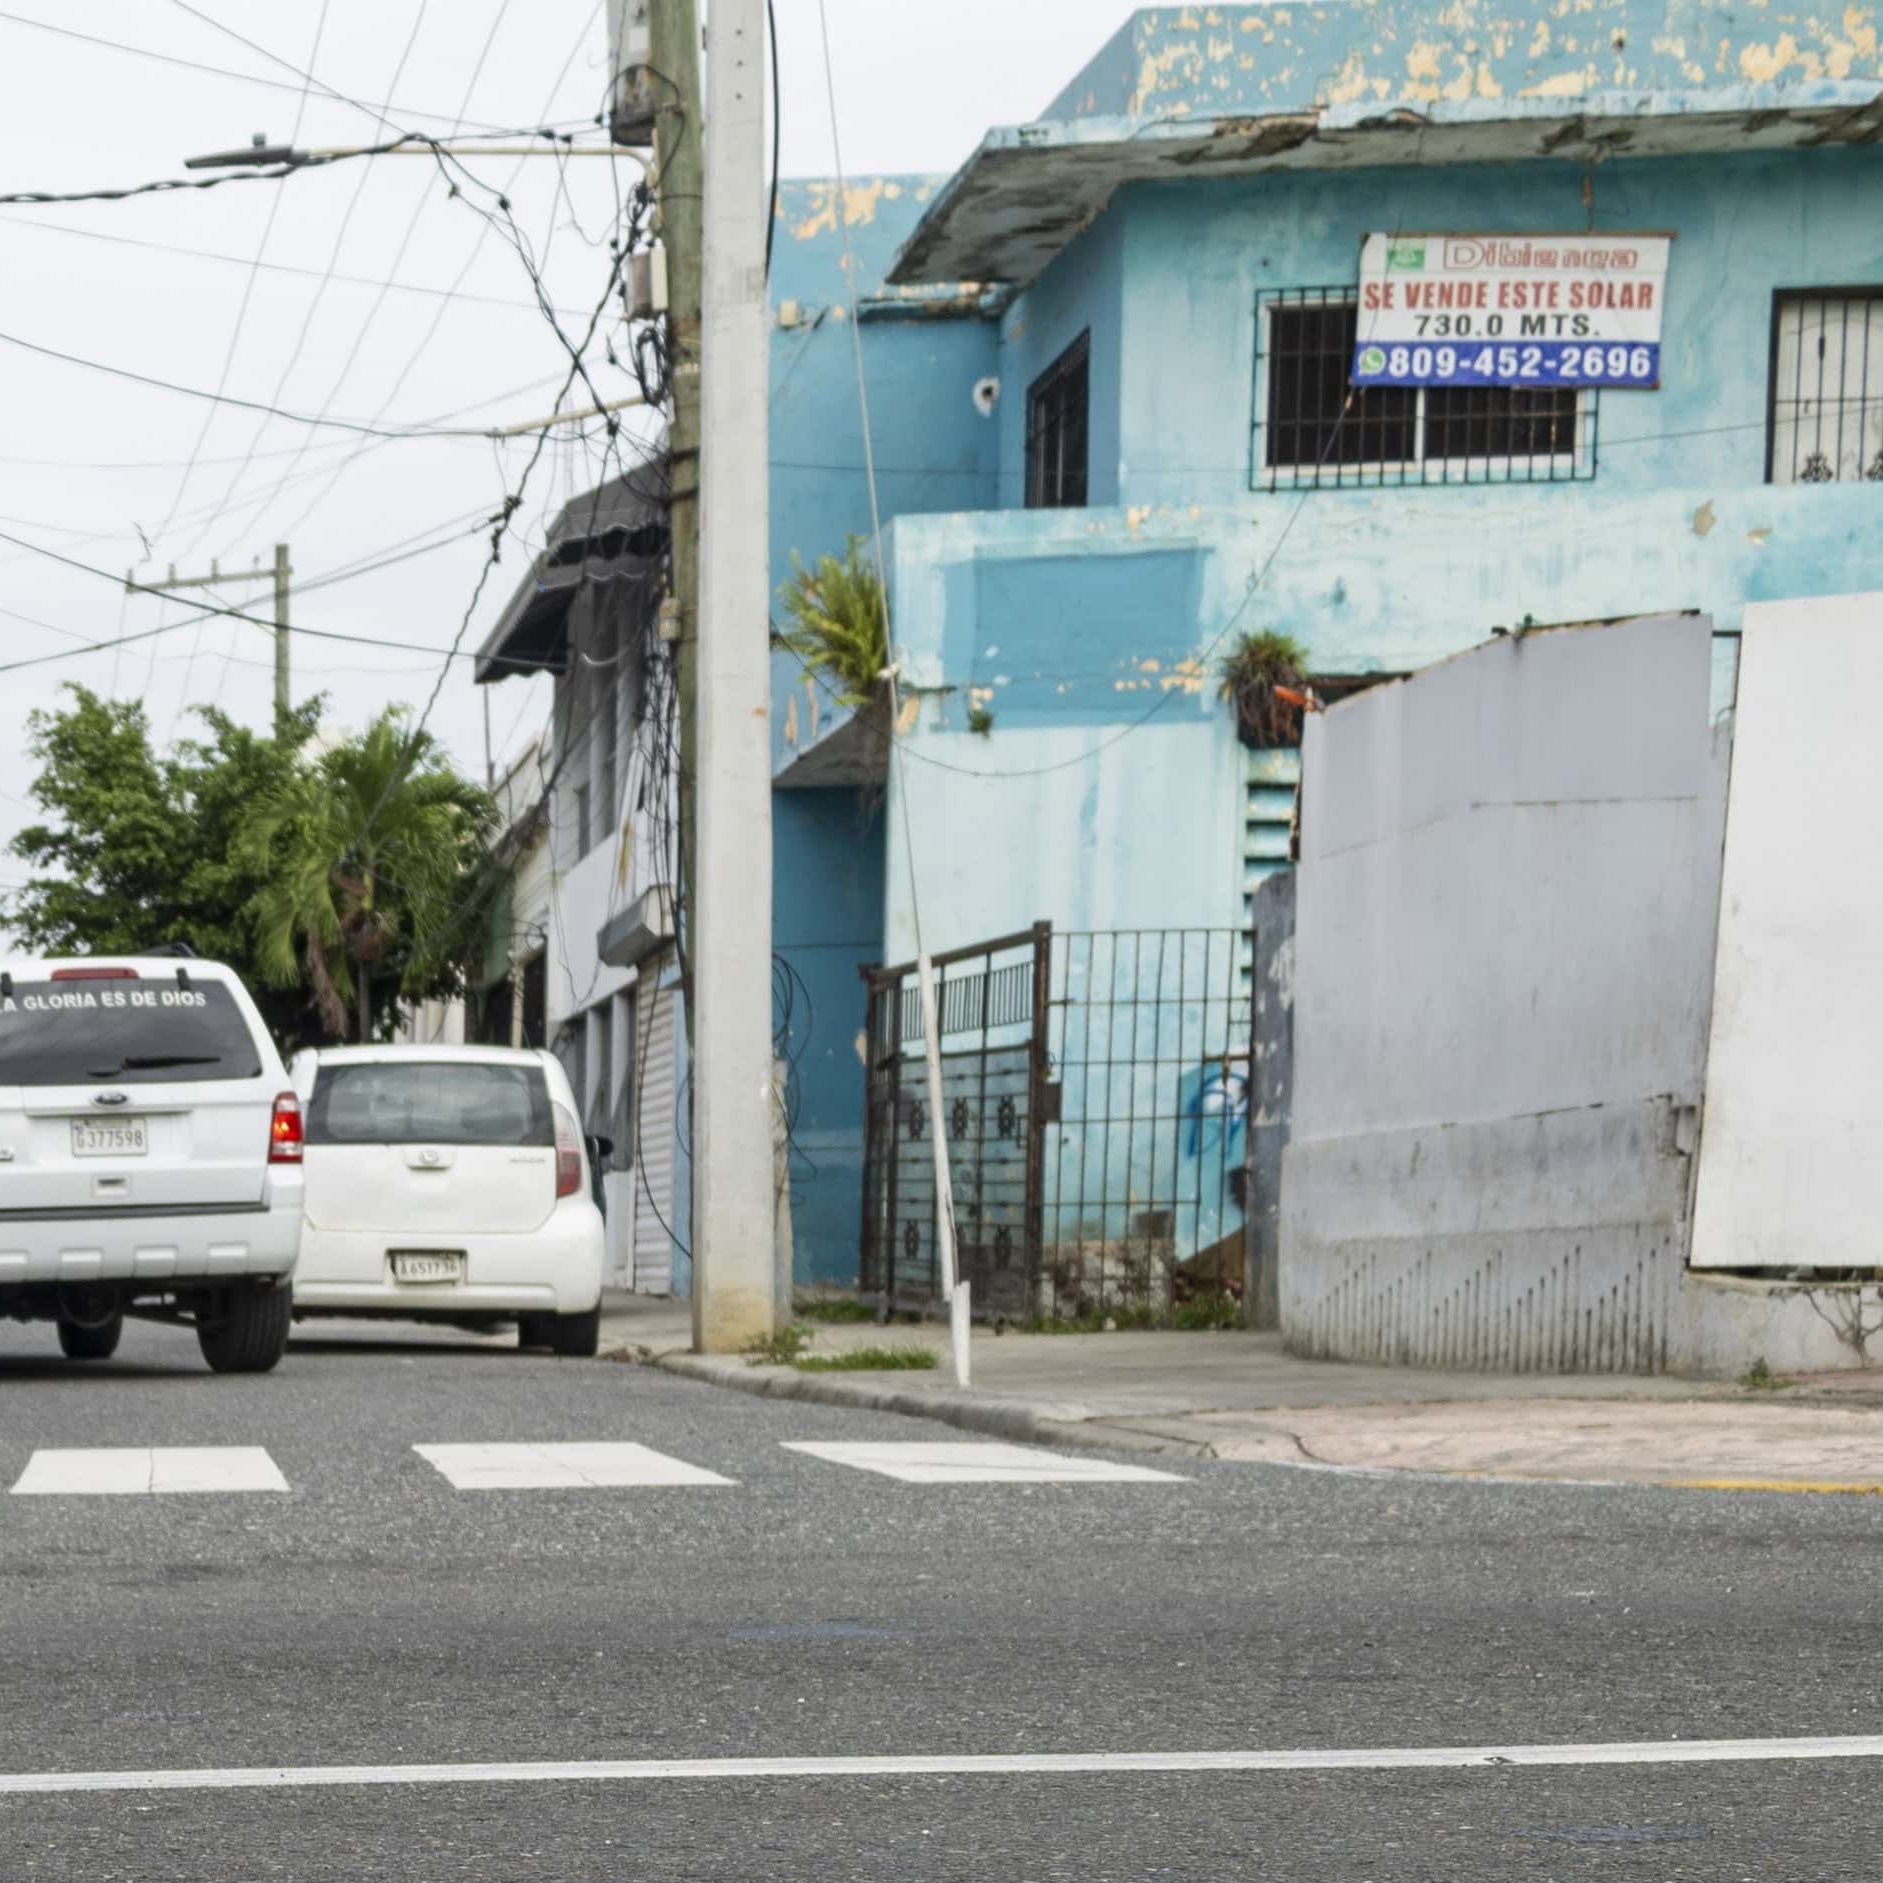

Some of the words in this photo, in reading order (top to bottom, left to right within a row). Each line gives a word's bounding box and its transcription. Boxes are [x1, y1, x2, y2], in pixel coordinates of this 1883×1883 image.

[1365, 281, 1395, 310] SE
[1405, 281, 1489, 310] VENDE
[1498, 281, 1560, 310] ESTE
[1569, 281, 1653, 310] SOLAR
[1414, 314, 1503, 337] 730.0
[1520, 313, 1601, 337] MTS.
[1389, 346, 1651, 378] 809-452-2696
[23, 991, 98, 1010] GLORIA
[101, 990, 126, 1007] ES
[131, 990, 157, 1007] DE
[161, 989, 207, 1007] DIOS
